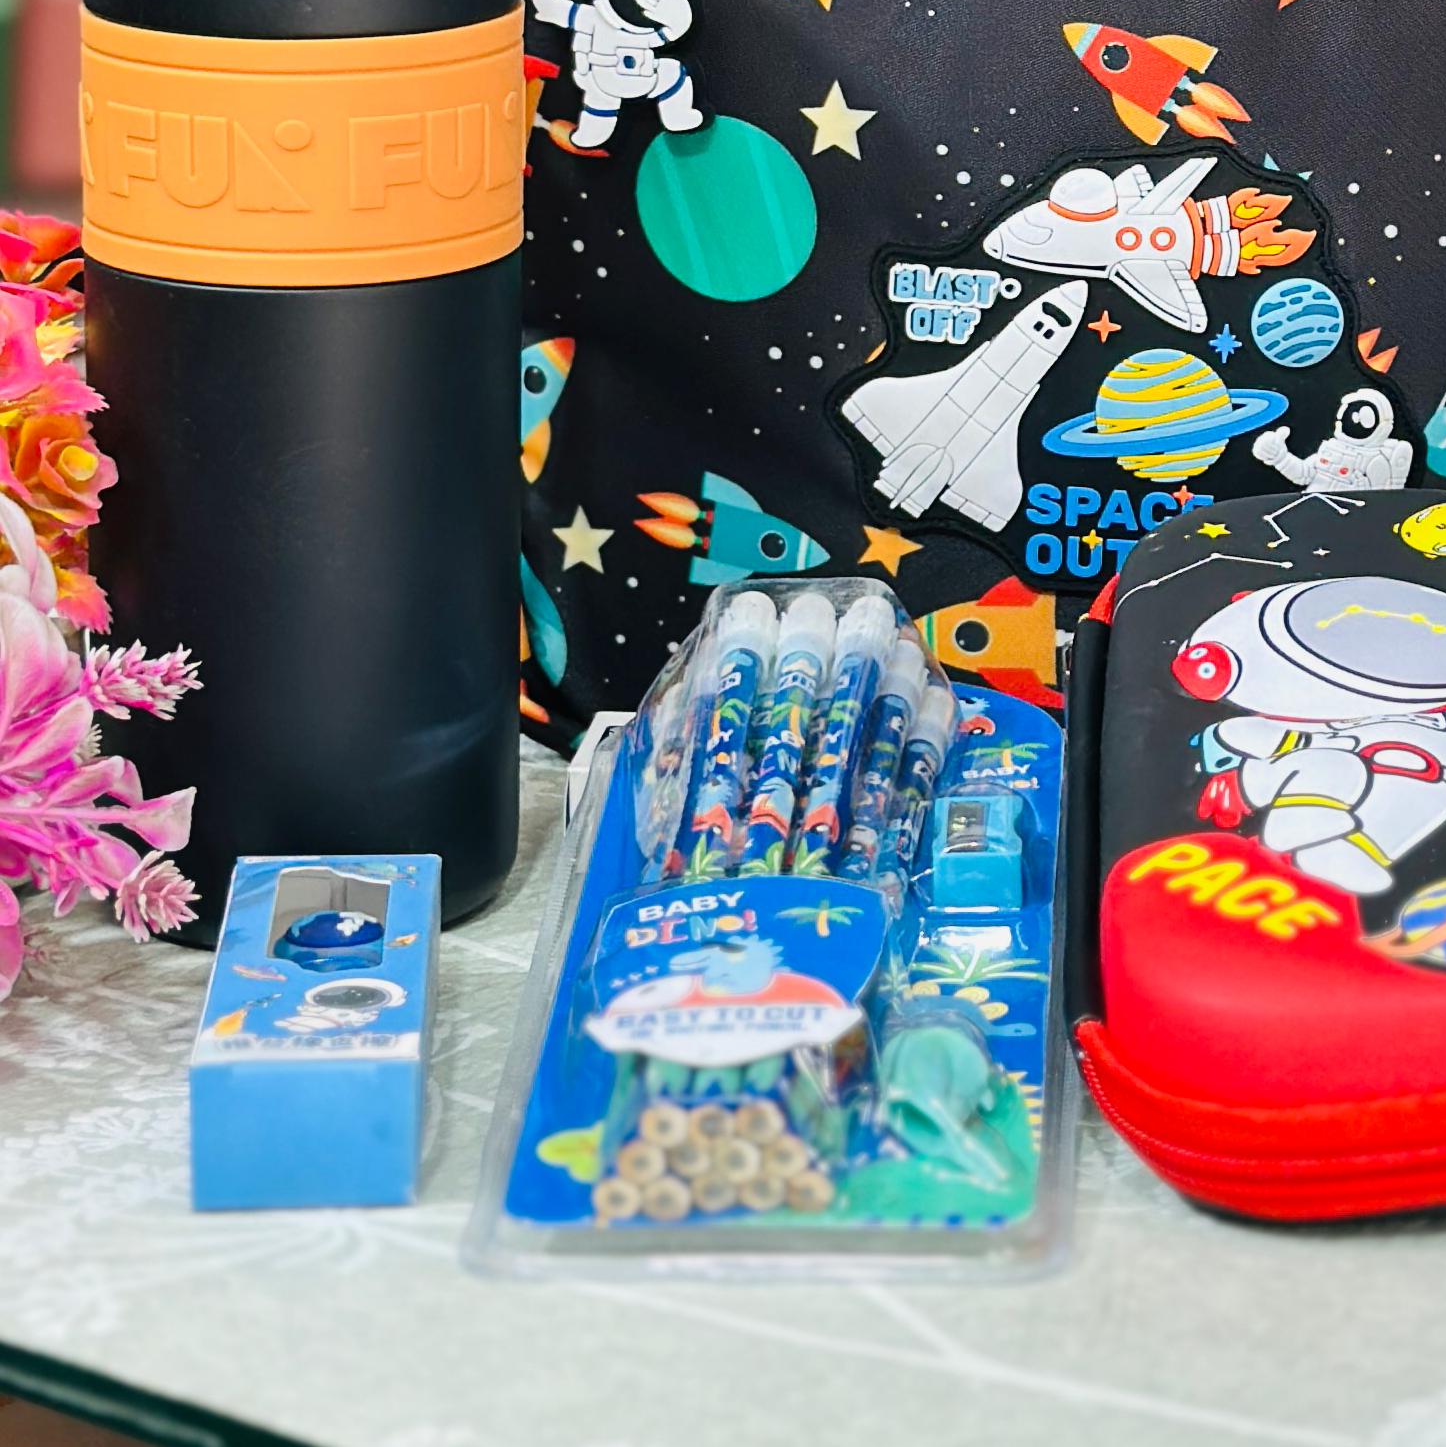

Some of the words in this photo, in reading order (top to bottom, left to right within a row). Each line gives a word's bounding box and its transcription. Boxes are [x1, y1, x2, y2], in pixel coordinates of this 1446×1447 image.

[890, 264, 999, 308] BLAST
[907, 304, 980, 343] OFF
[638, 891, 744, 923] BABY
[1128, 842, 1340, 939] PACE
[624, 909, 758, 948] DINO!
